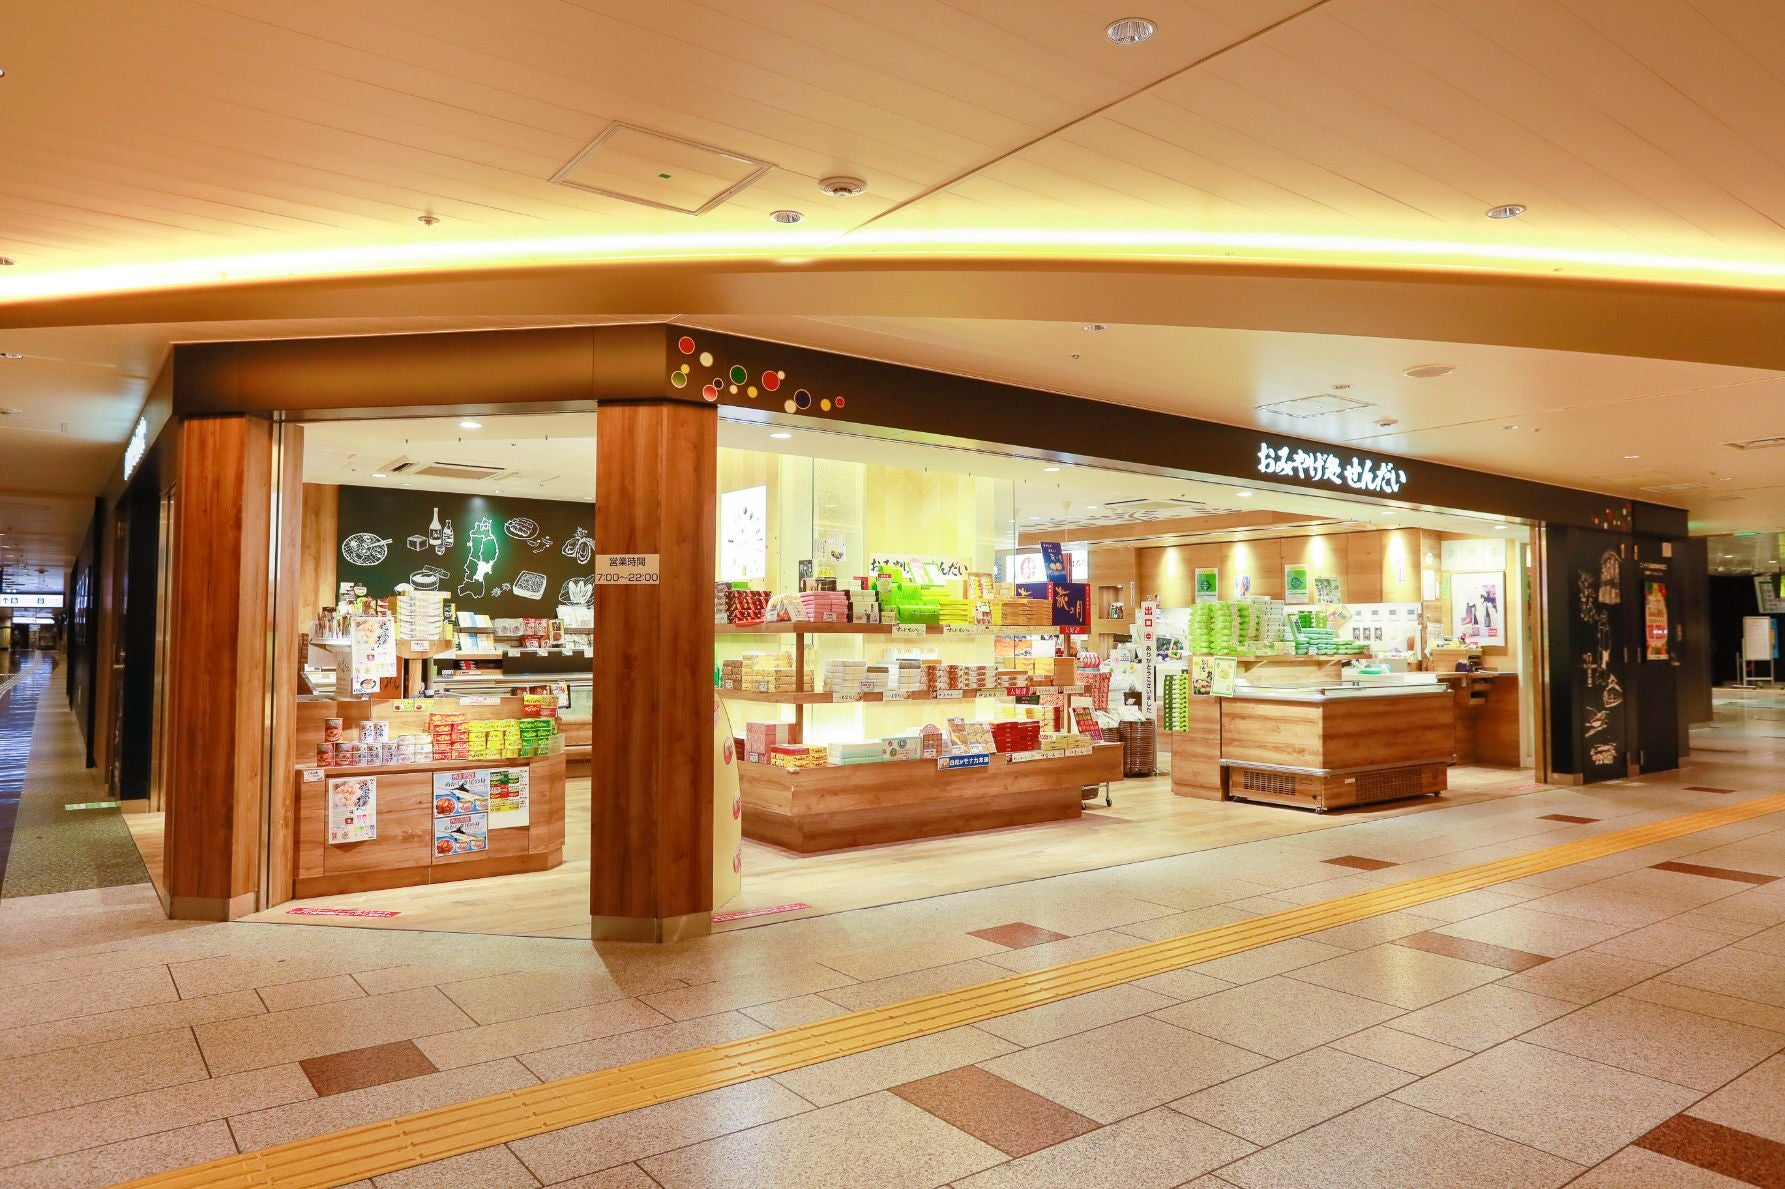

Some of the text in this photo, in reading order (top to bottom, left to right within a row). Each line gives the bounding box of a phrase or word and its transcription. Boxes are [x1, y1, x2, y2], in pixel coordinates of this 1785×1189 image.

[1257, 442, 1407, 493] おみやげ処 せんだい
[609, 556, 646, 567] 営業時間
[596, 573, 659, 582] 7:00～22:00
